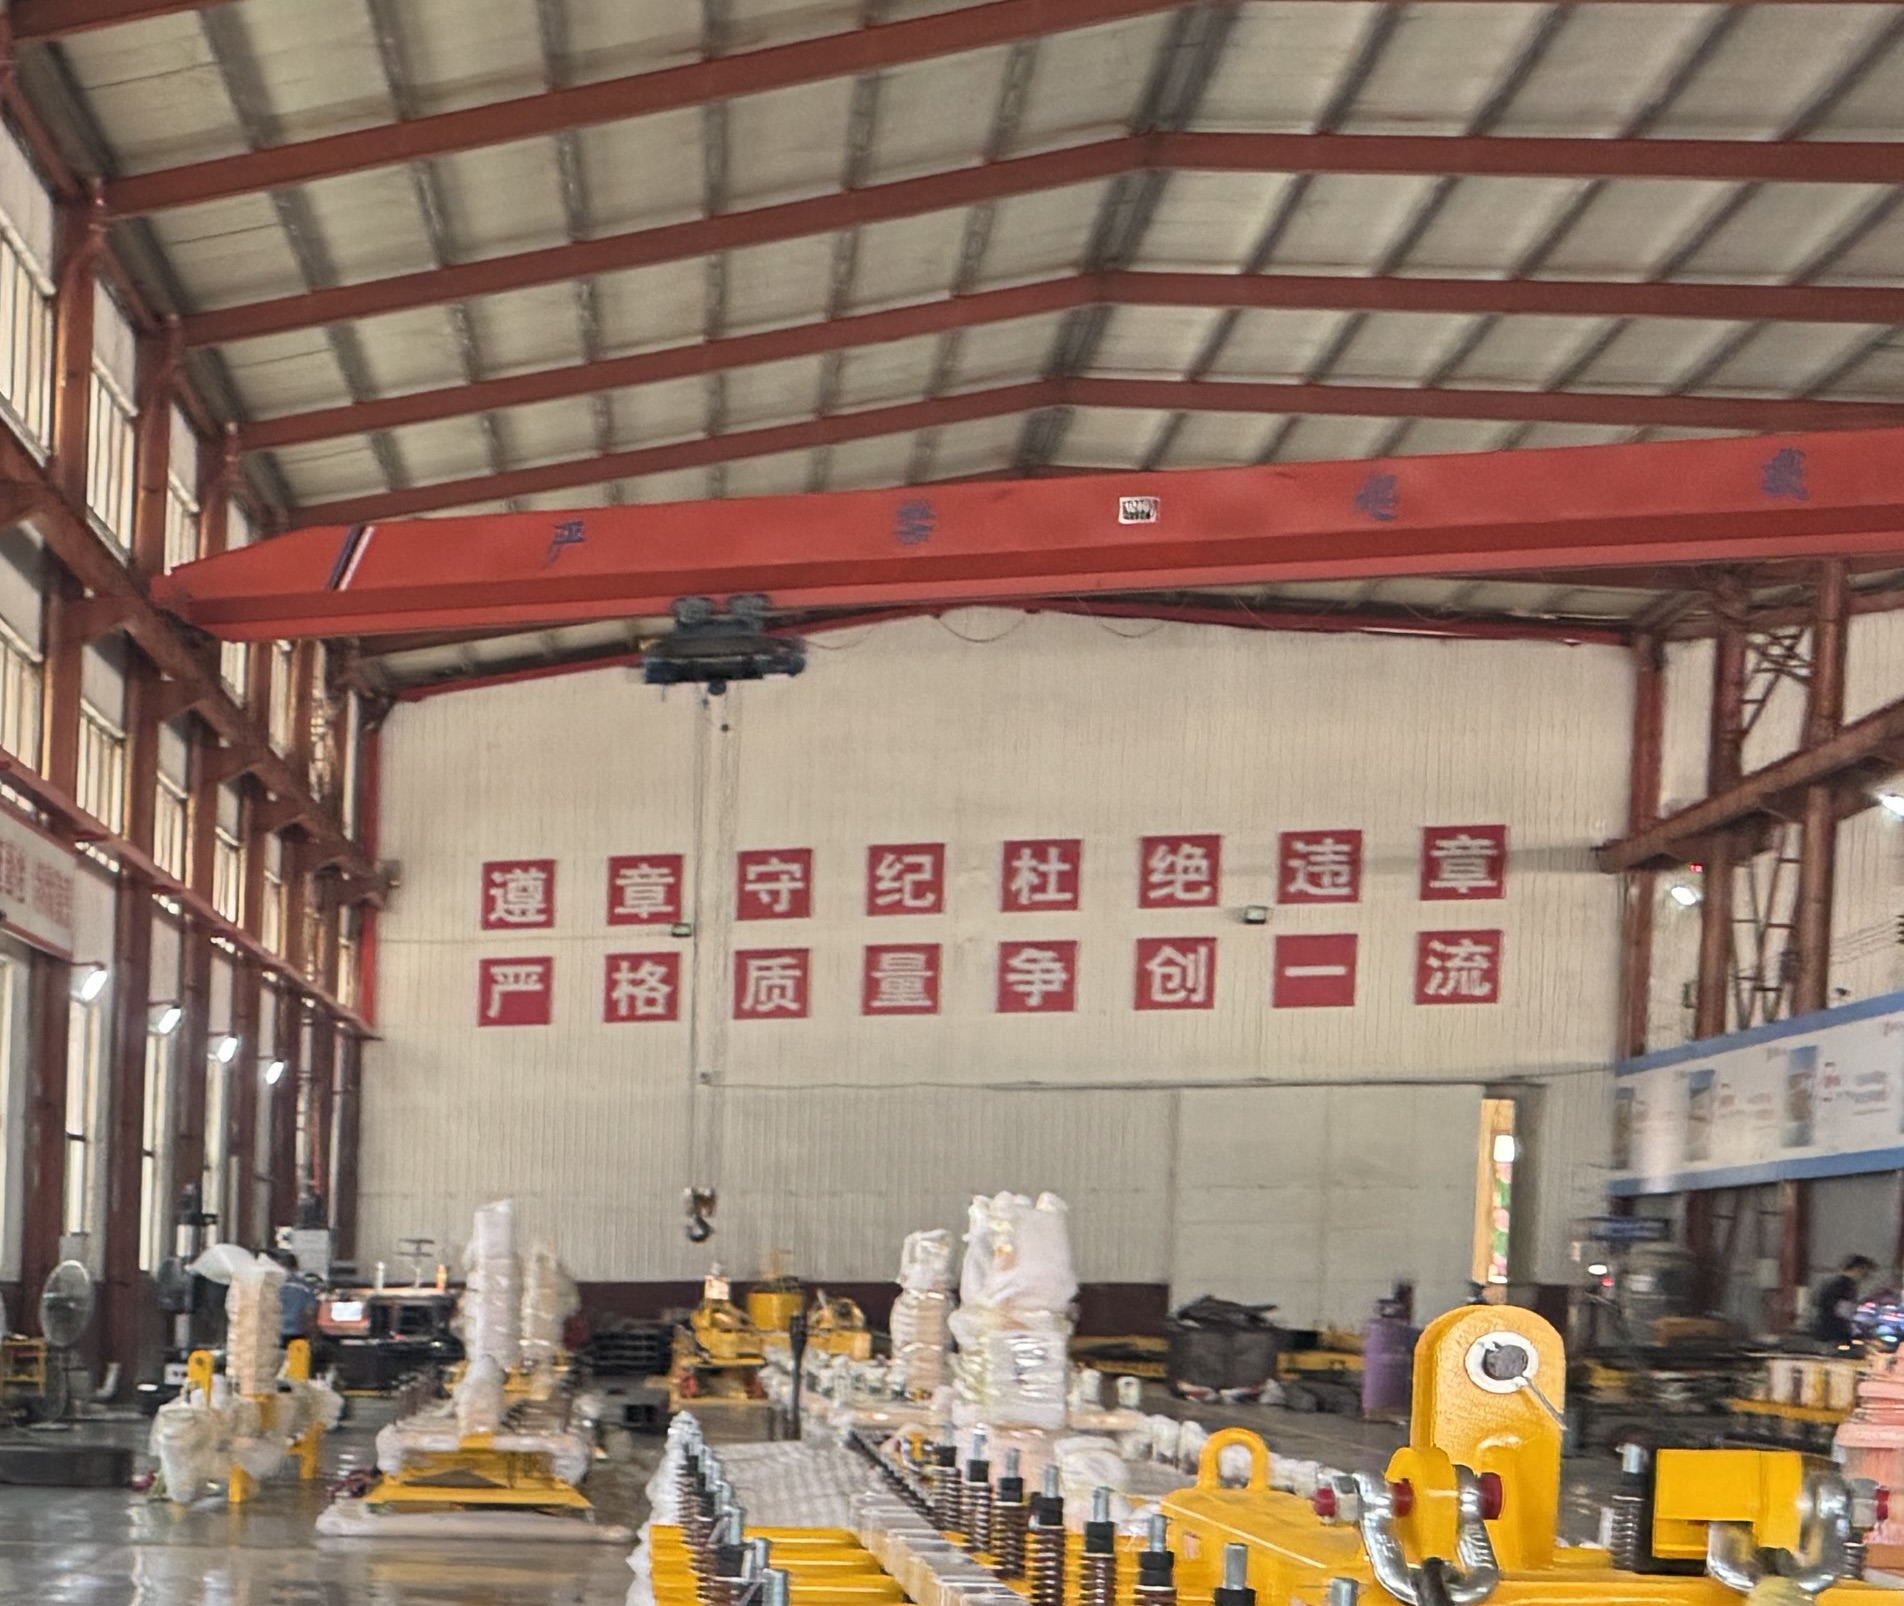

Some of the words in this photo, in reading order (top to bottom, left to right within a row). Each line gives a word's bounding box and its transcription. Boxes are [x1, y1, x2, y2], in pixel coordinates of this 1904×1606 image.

[488, 834, 1497, 923] 遵章守纪杜绝违章
[487, 938, 1493, 1018] 严格质量争创一流
